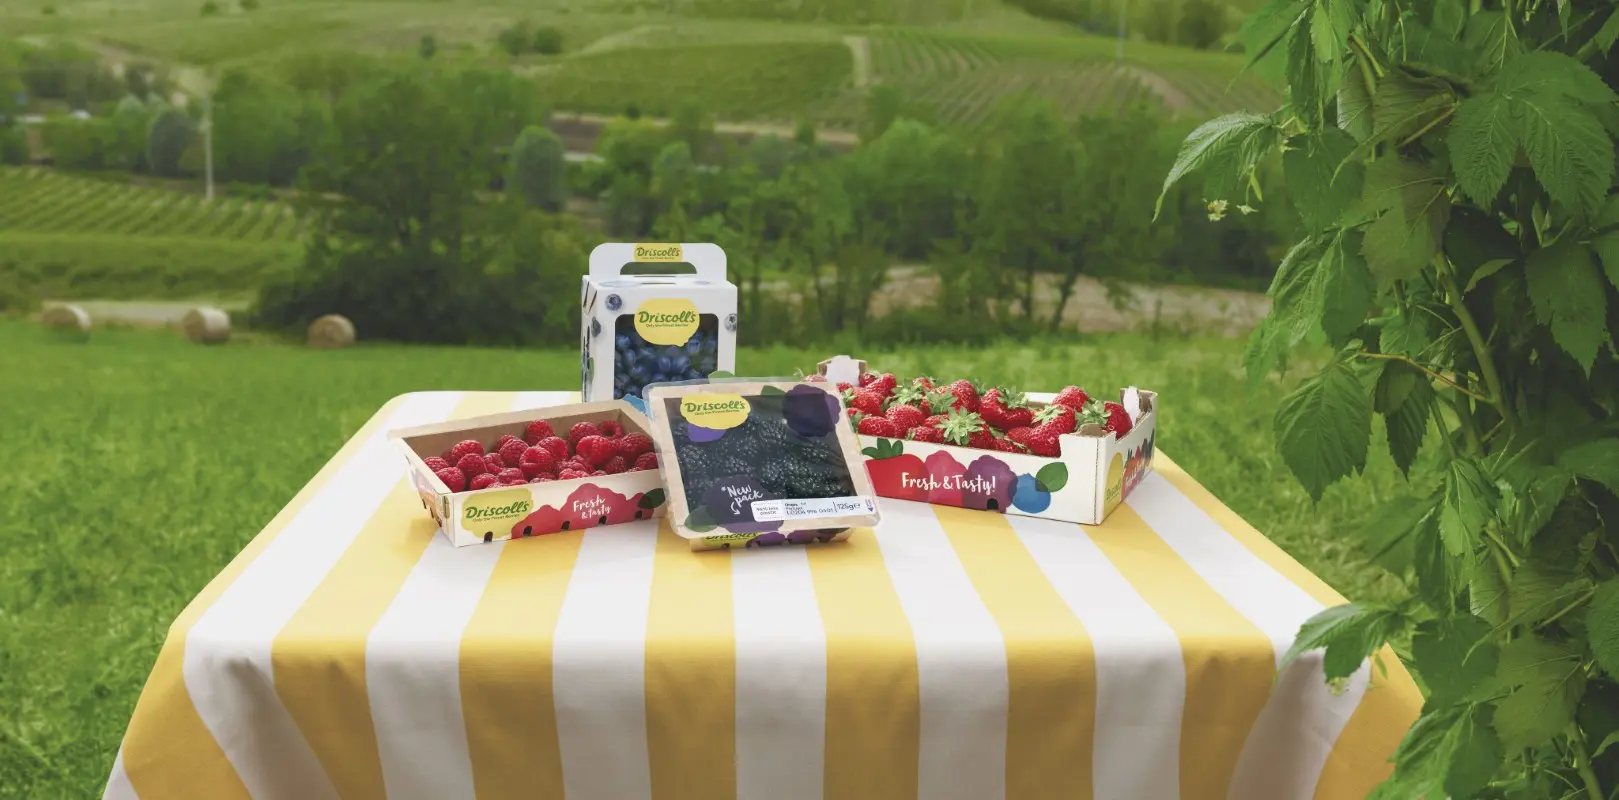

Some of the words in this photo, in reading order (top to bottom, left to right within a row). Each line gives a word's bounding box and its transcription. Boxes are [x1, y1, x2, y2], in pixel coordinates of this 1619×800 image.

[636, 246, 681, 257] Driscoll's
[638, 310, 697, 323] Driscoll's
[684, 400, 746, 413] Driscoll's
[901, 471, 942, 491] Fresh
[943, 475, 953, 490] &
[952, 474, 996, 496] Tasty!
[573, 494, 606, 512] Fresh
[734, 490, 764, 508] pack
[465, 500, 530, 519] Driscoll's
[581, 511, 589, 520] &
[589, 504, 612, 519] tasty
